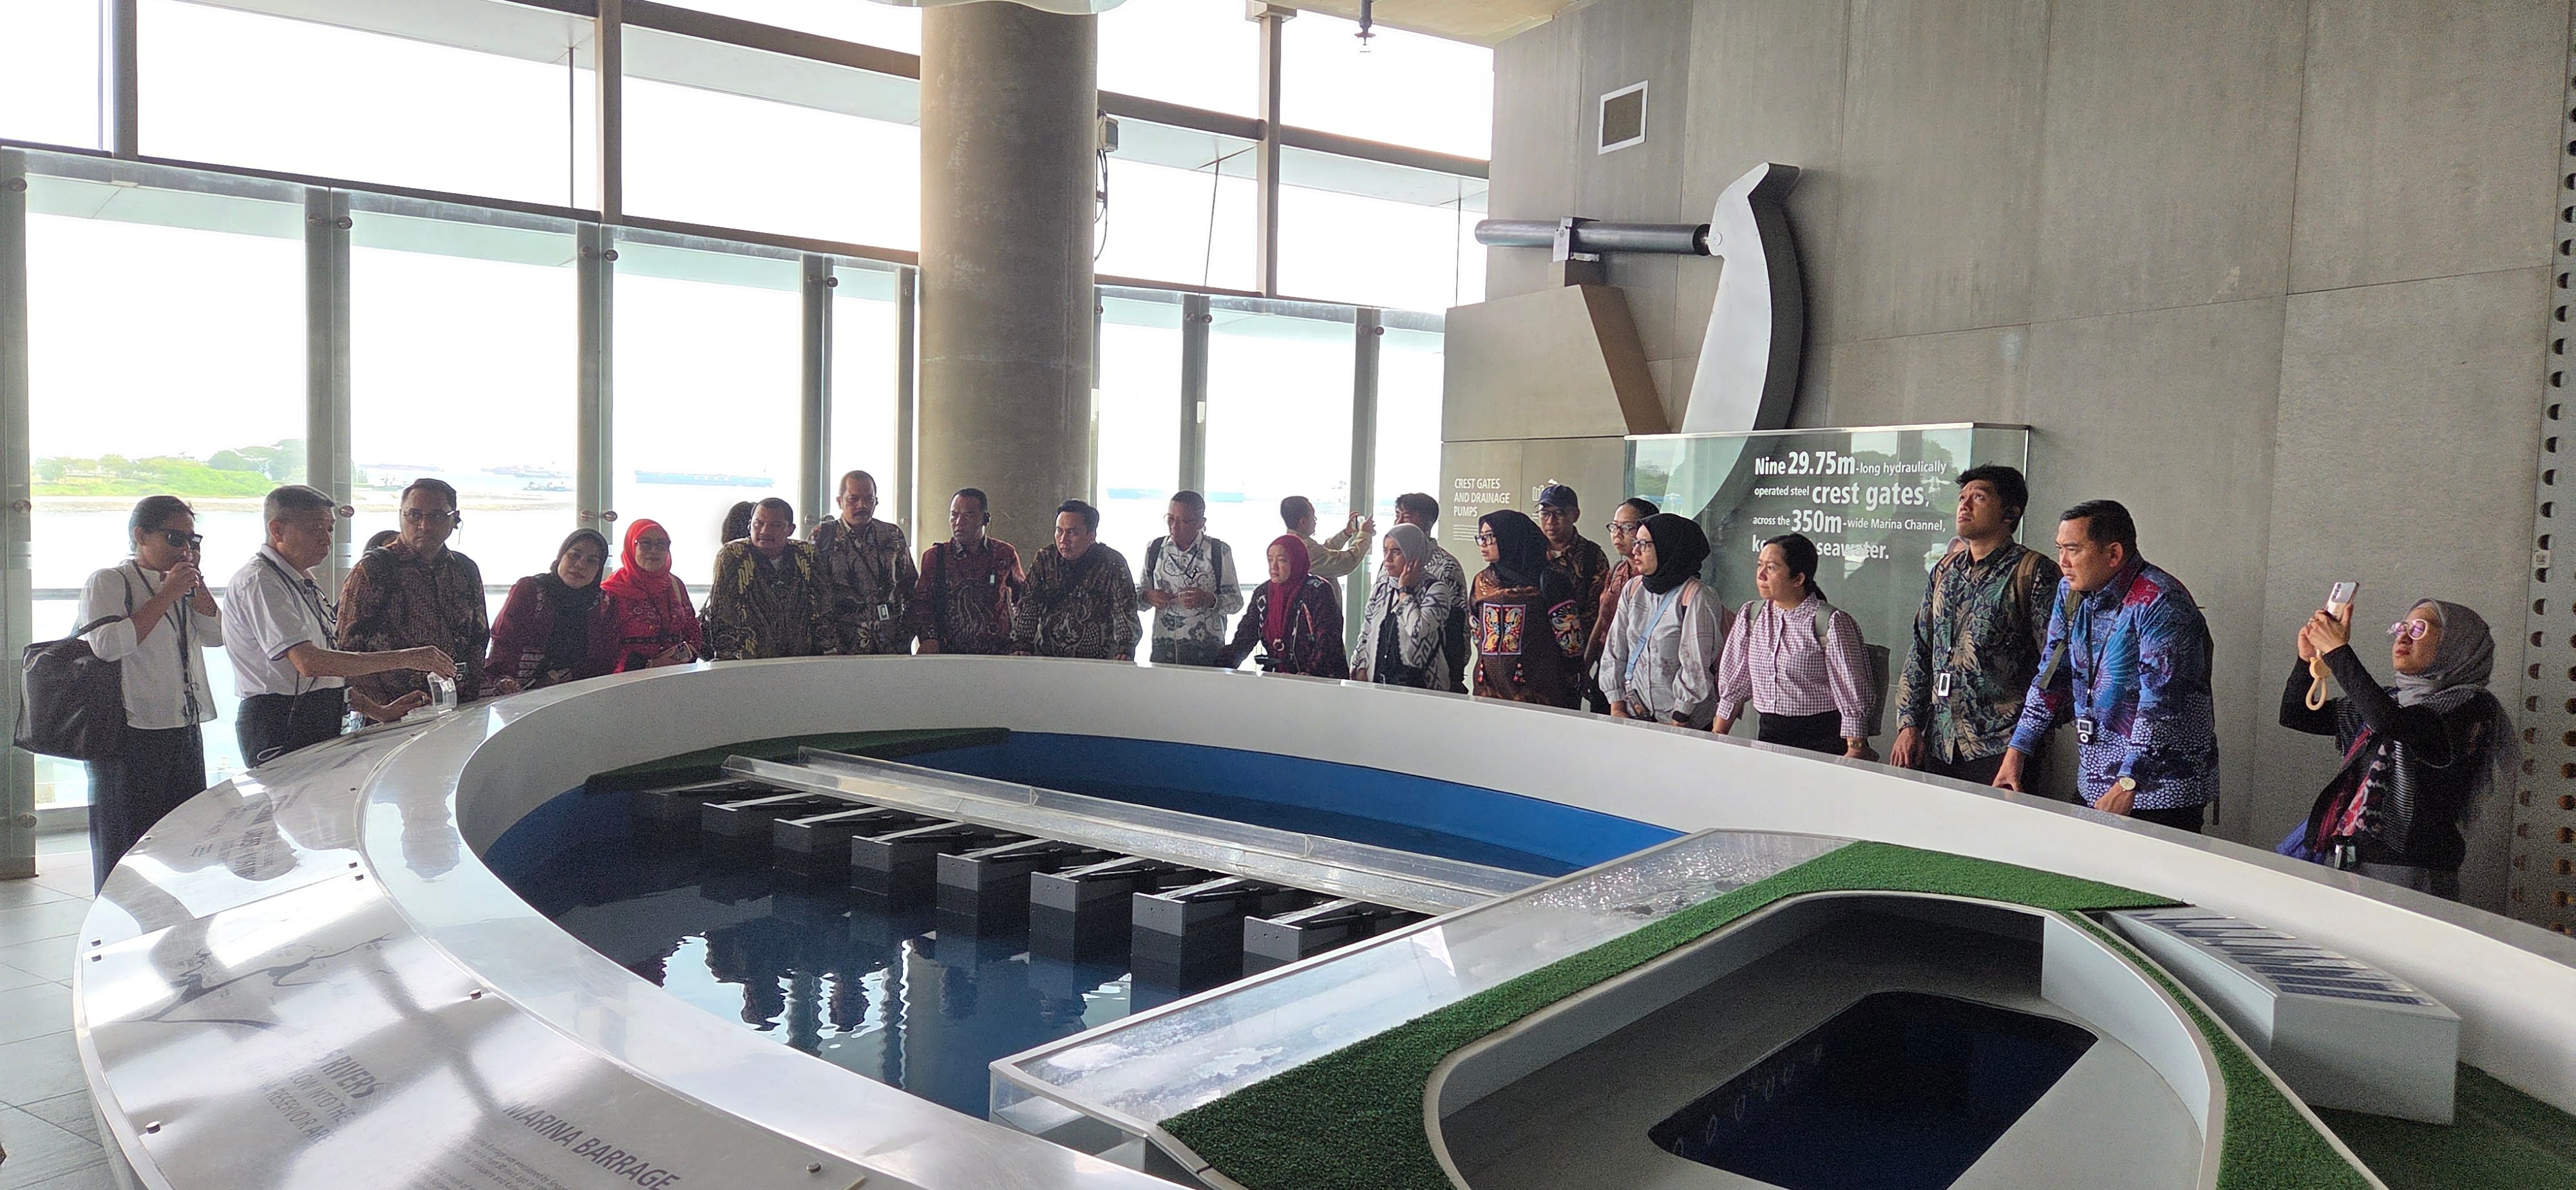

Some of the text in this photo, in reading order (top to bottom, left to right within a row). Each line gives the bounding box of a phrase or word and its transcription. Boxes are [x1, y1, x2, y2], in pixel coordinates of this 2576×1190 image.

[1755, 457, 1786, 475] Nine
[1883, 460, 1947, 476] hydraulically
[1454, 478, 1501, 489] CREST GATES
[1454, 493, 1510, 504] AND DRAINAGE
[1754, 482, 1930, 511] operated steel crest gates,
[1454, 506, 1477, 516] PUMPS
[1777, 516, 1790, 526] the
[1871, 518, 1902, 529] Marina
[1904, 519, 1946, 533] Channel,
[319, 1055, 388, 1099] RIVERS
[264, 1088, 317, 1130] RESERVOIR
[305, 1086, 338, 1107] INTO
[325, 1102, 357, 1122] THE
[503, 1100, 583, 1148] MARINA
[571, 1137, 681, 1190] BARRAGE
